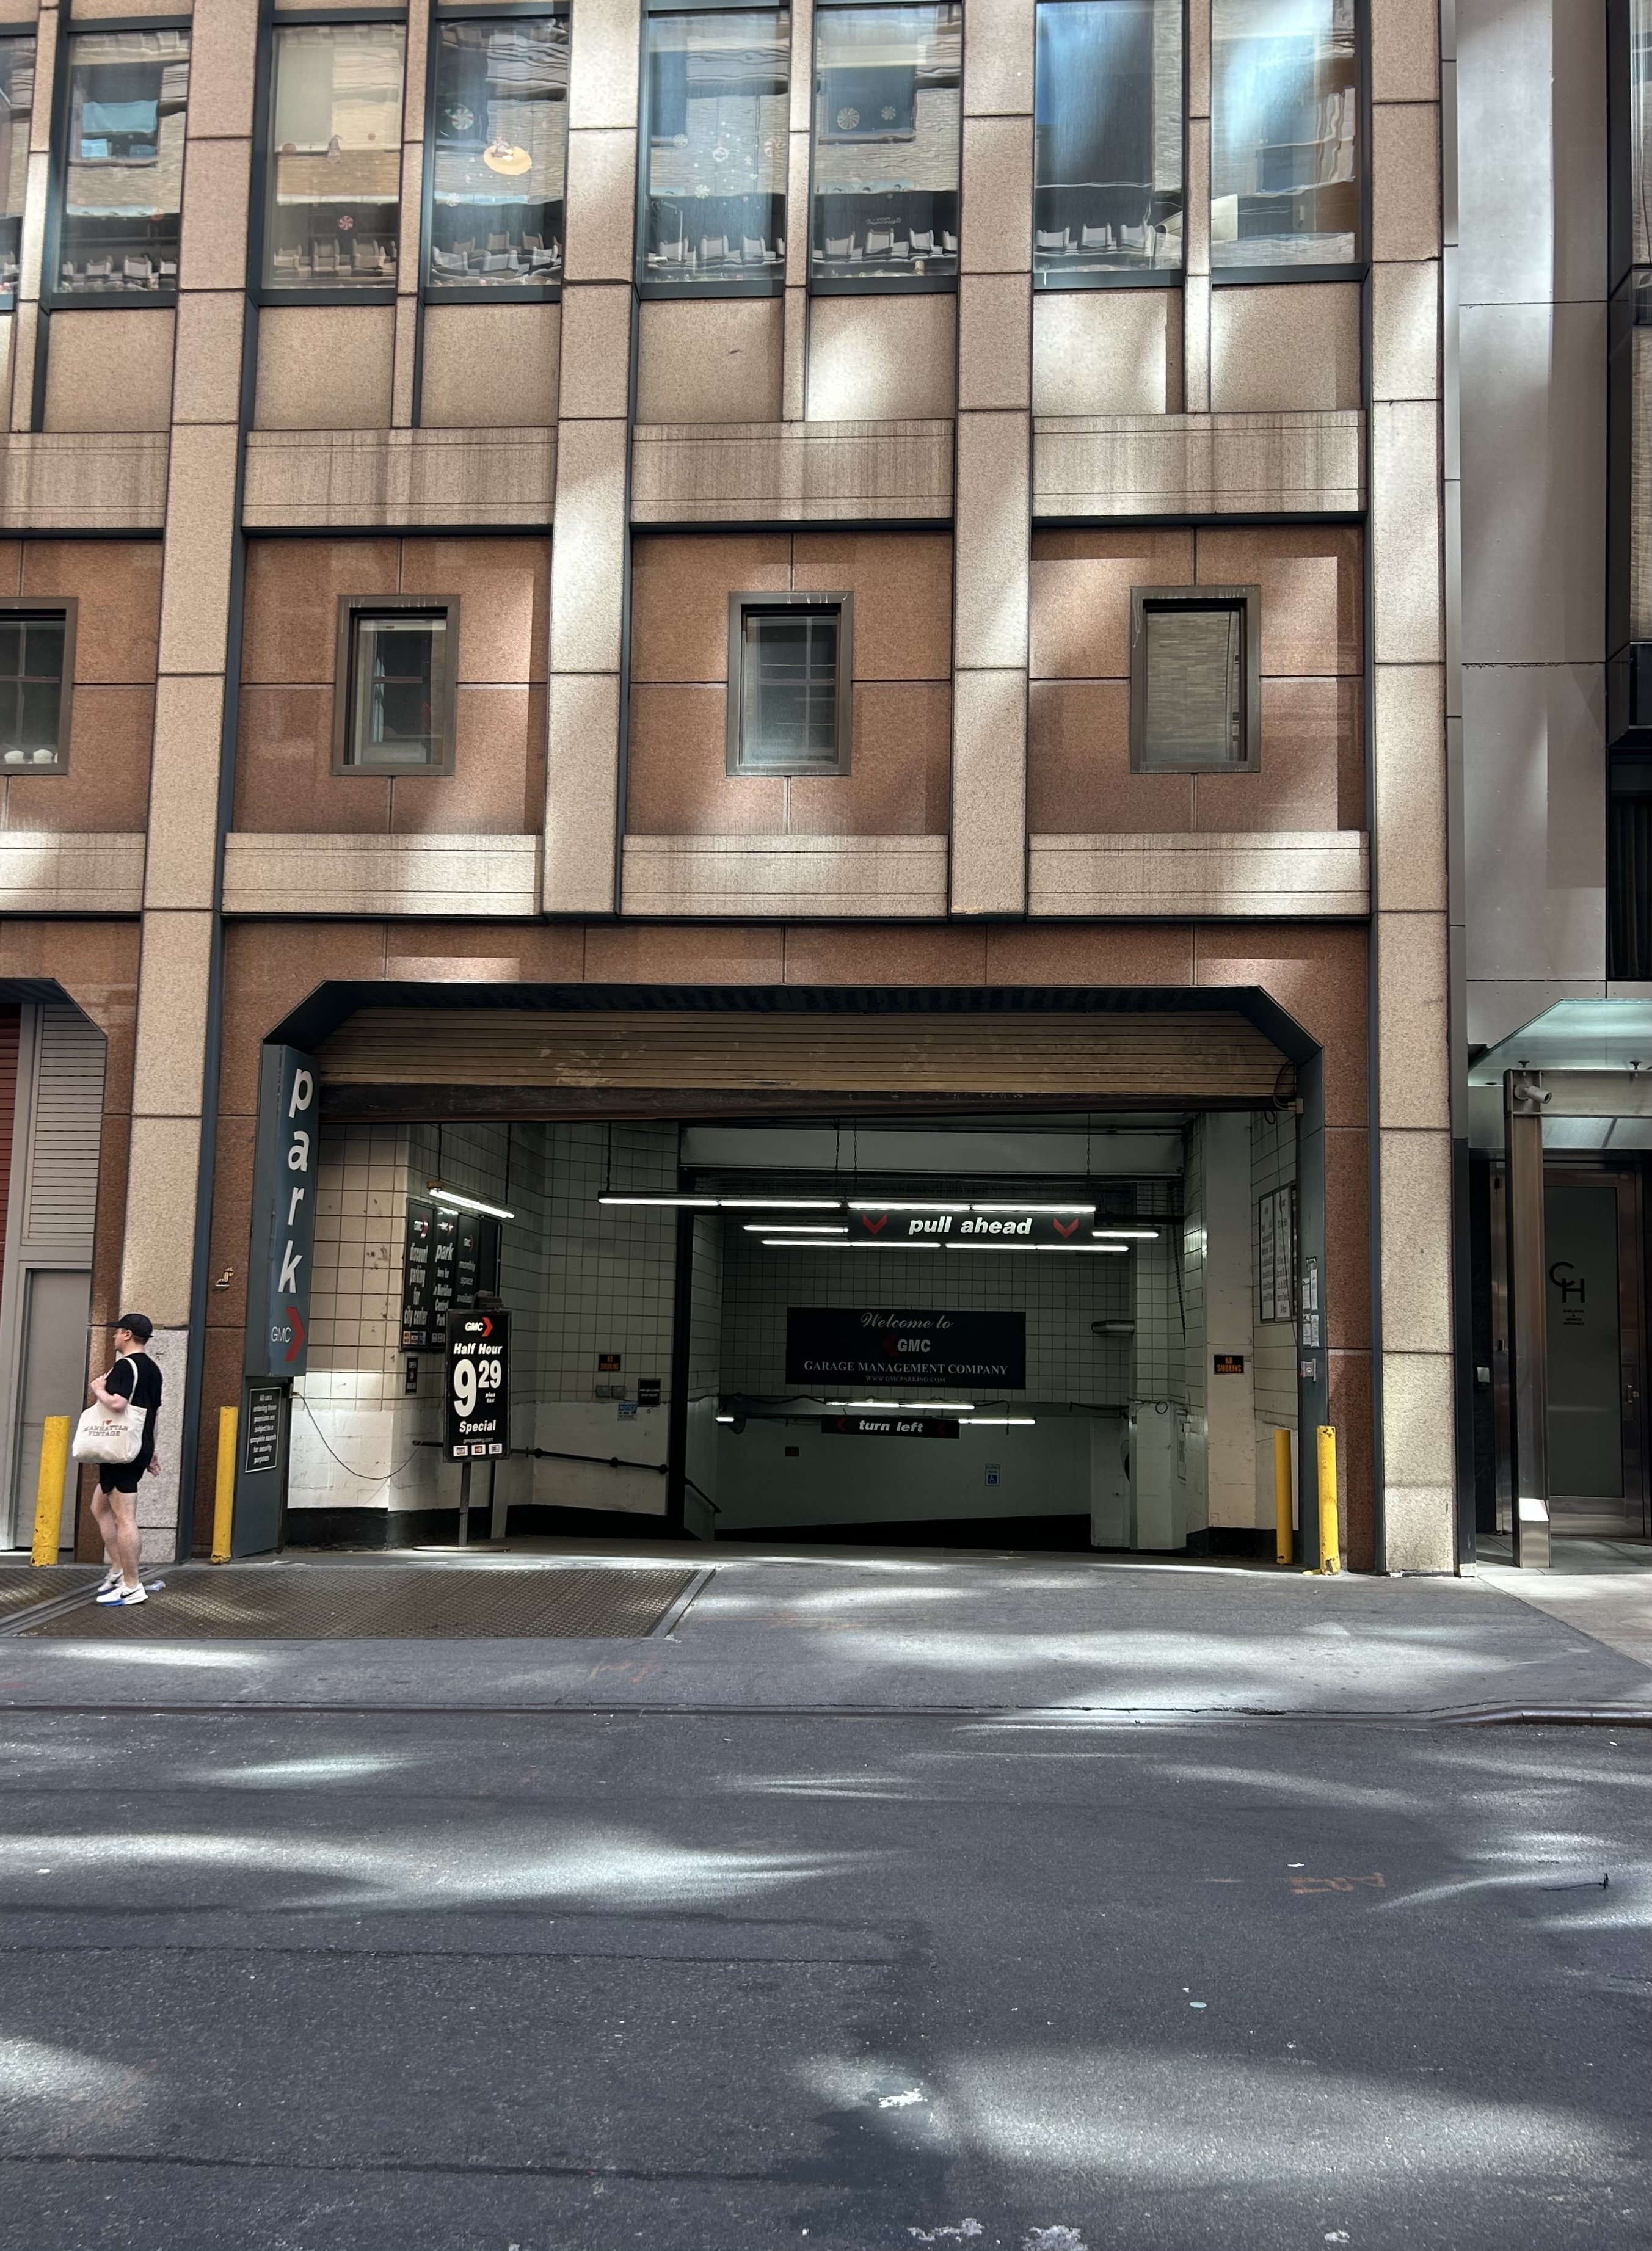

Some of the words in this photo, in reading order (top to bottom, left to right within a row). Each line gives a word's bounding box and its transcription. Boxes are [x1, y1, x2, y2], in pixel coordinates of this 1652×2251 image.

[278, 1068, 313, 1293] park
[908, 1216, 952, 1235] pull
[960, 1218, 1032, 1234] ahead
[435, 1242, 454, 1263] park
[409, 1265, 426, 1287] parking
[404, 1305, 413, 1328] city
[413, 1306, 428, 1325] center
[860, 1312, 934, 1329] Welcome
[935, 1315, 954, 1329] to
[271, 1326, 291, 1343] GMC
[465, 1322, 484, 1331] GMC
[453, 1343, 476, 1355] Half
[478, 1343, 503, 1355] Hour
[897, 1339, 931, 1353] GMC
[478, 1360, 502, 1389] 29
[804, 1361, 854, 1372] GARAGE
[858, 1362, 945, 1373] MANAGEMENT
[948, 1364, 1008, 1375] COMPANY
[1217, 1364, 1242, 1373] SMOKING
[459, 1420, 497, 1434] Special
[859, 1420, 890, 1430] turn
[897, 1422, 923, 1433] left
